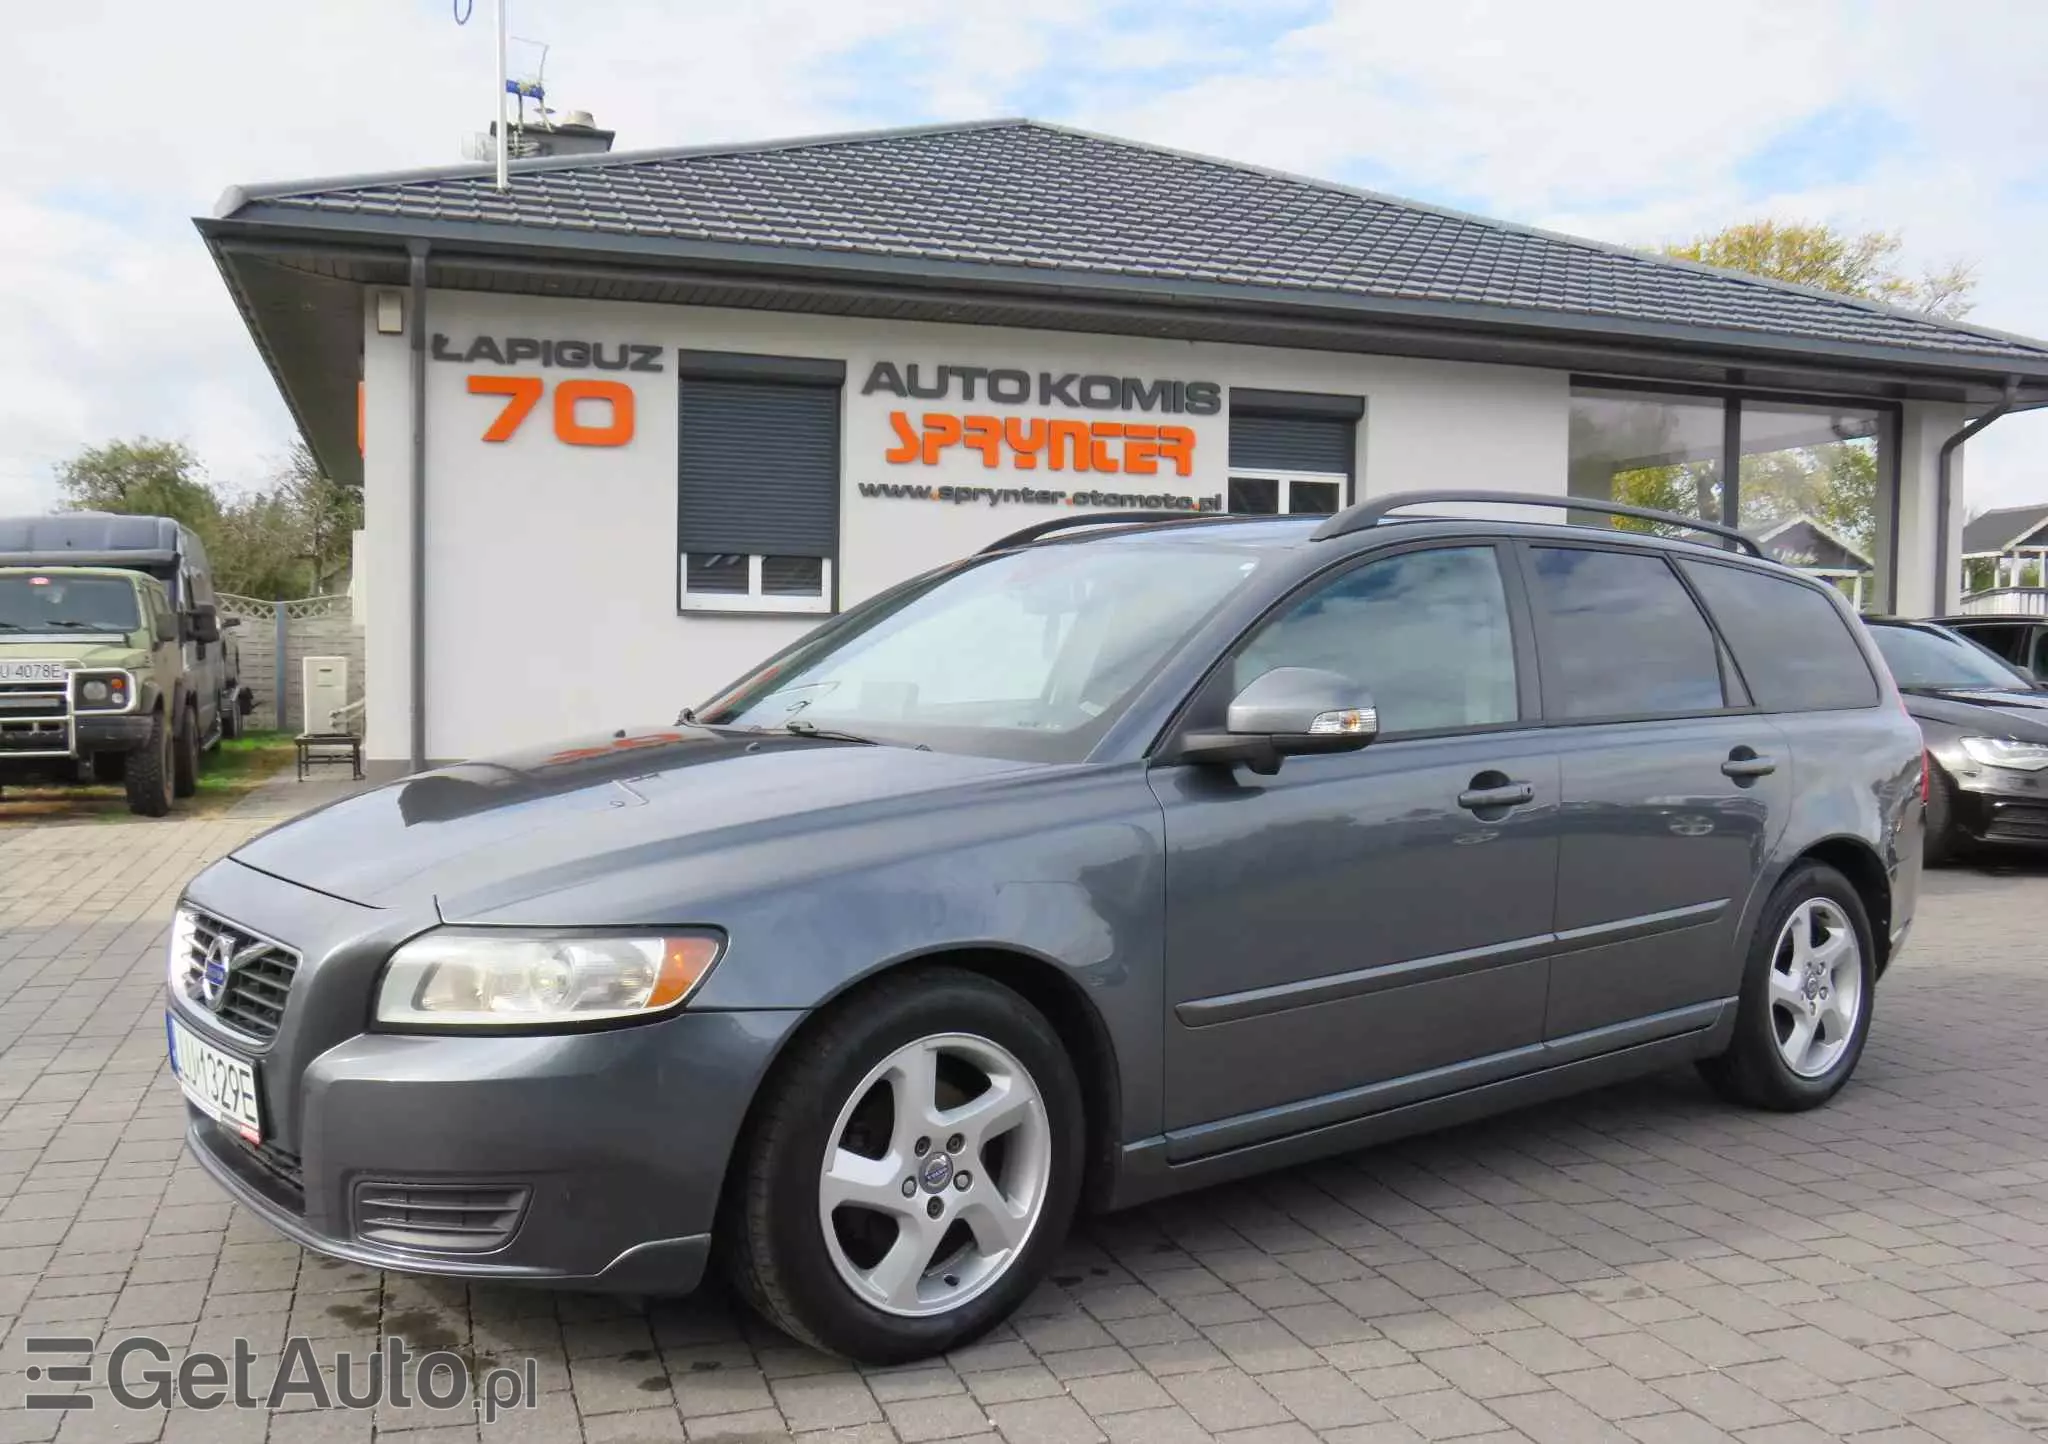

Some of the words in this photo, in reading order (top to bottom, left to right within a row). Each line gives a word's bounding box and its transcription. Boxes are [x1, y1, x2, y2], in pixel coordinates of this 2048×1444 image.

[431, 333, 664, 372] ŁAPIGUZ
[467, 375, 636, 447] 70
[861, 361, 1031, 406] AUTO
[1038, 372, 1222, 415] KOMIS
[886, 411, 1196, 477] SPRYNTER
[858, 482, 1222, 512] www.sprynter.otomoto.pl
